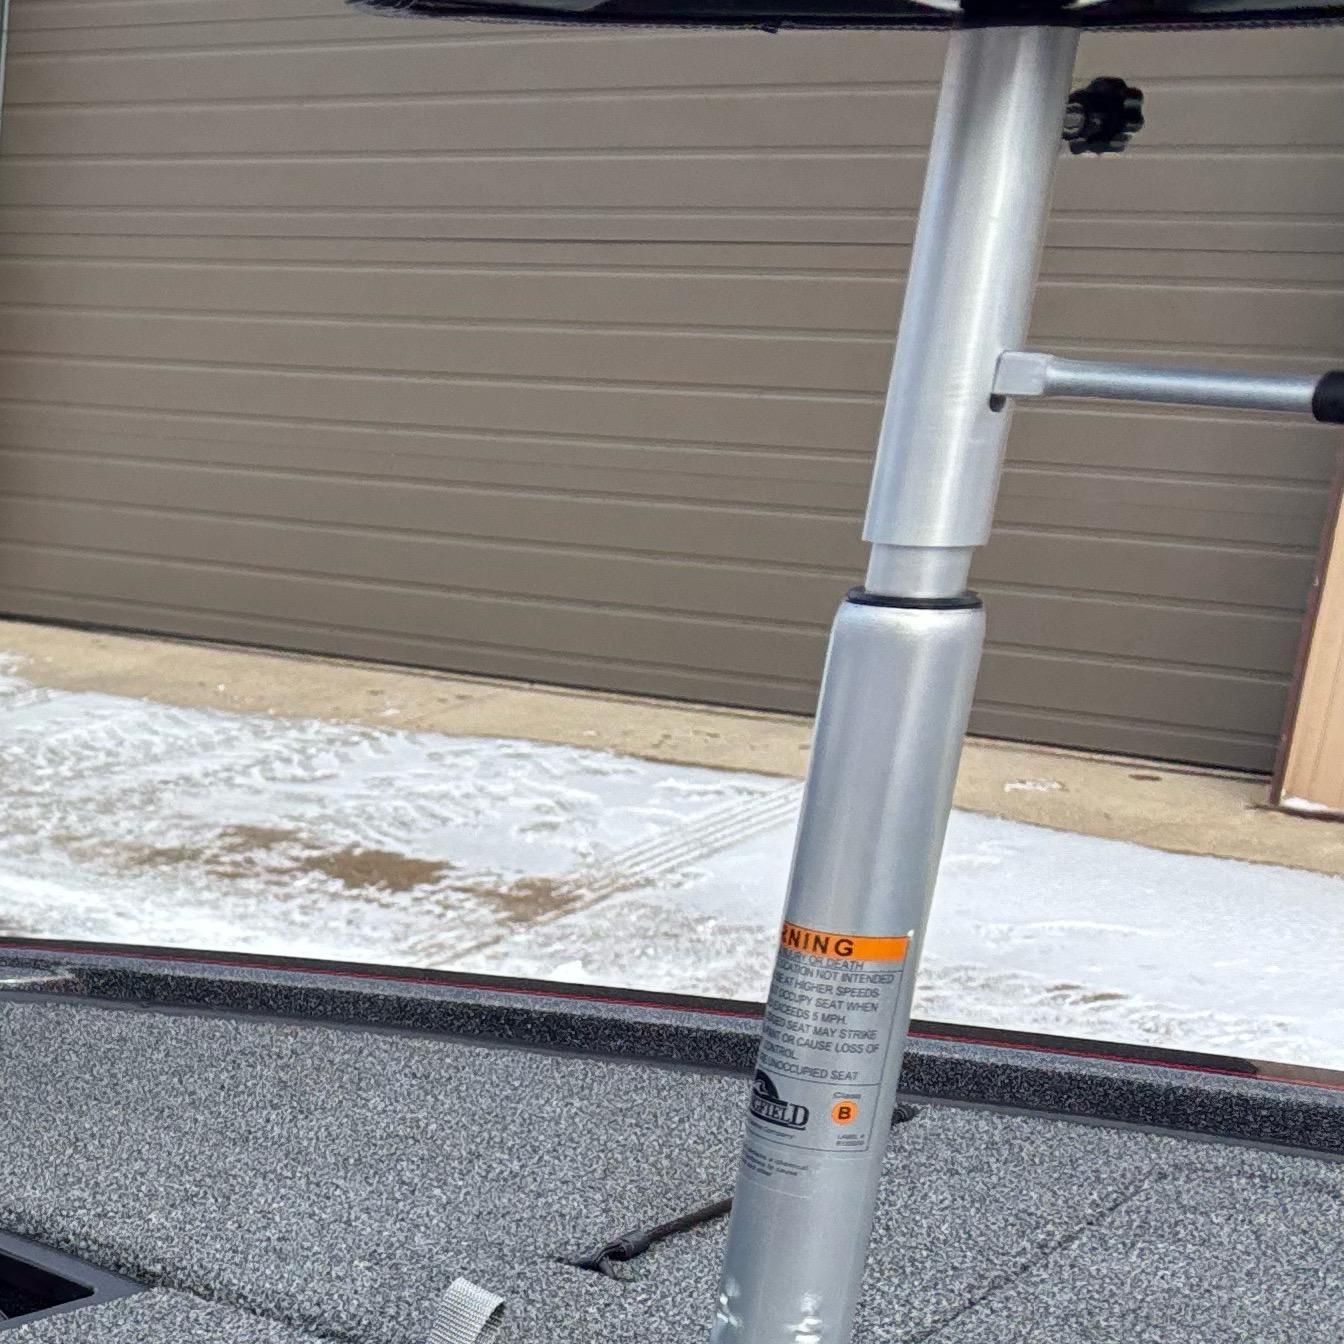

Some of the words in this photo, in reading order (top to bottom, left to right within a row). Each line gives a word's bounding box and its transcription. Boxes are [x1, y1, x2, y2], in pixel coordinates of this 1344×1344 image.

[826, 957, 865, 971] DEATH
[841, 972, 895, 985] INTENDED
[836, 986, 880, 999] SPEEDS
[815, 997, 843, 1010] SEAT
[846, 1001, 879, 1013] WHEN
[787, 1019, 811, 1033] SEAT
[812, 1024, 837, 1037] MAY
[838, 1028, 878, 1040] STRIKE
[796, 1036, 832, 1051] CAUSE
[835, 1042, 862, 1054] LOSS
[865, 1043, 880, 1054] OF
[830, 1069, 859, 1081] SEAT
[838, 1106, 852, 1120] B
